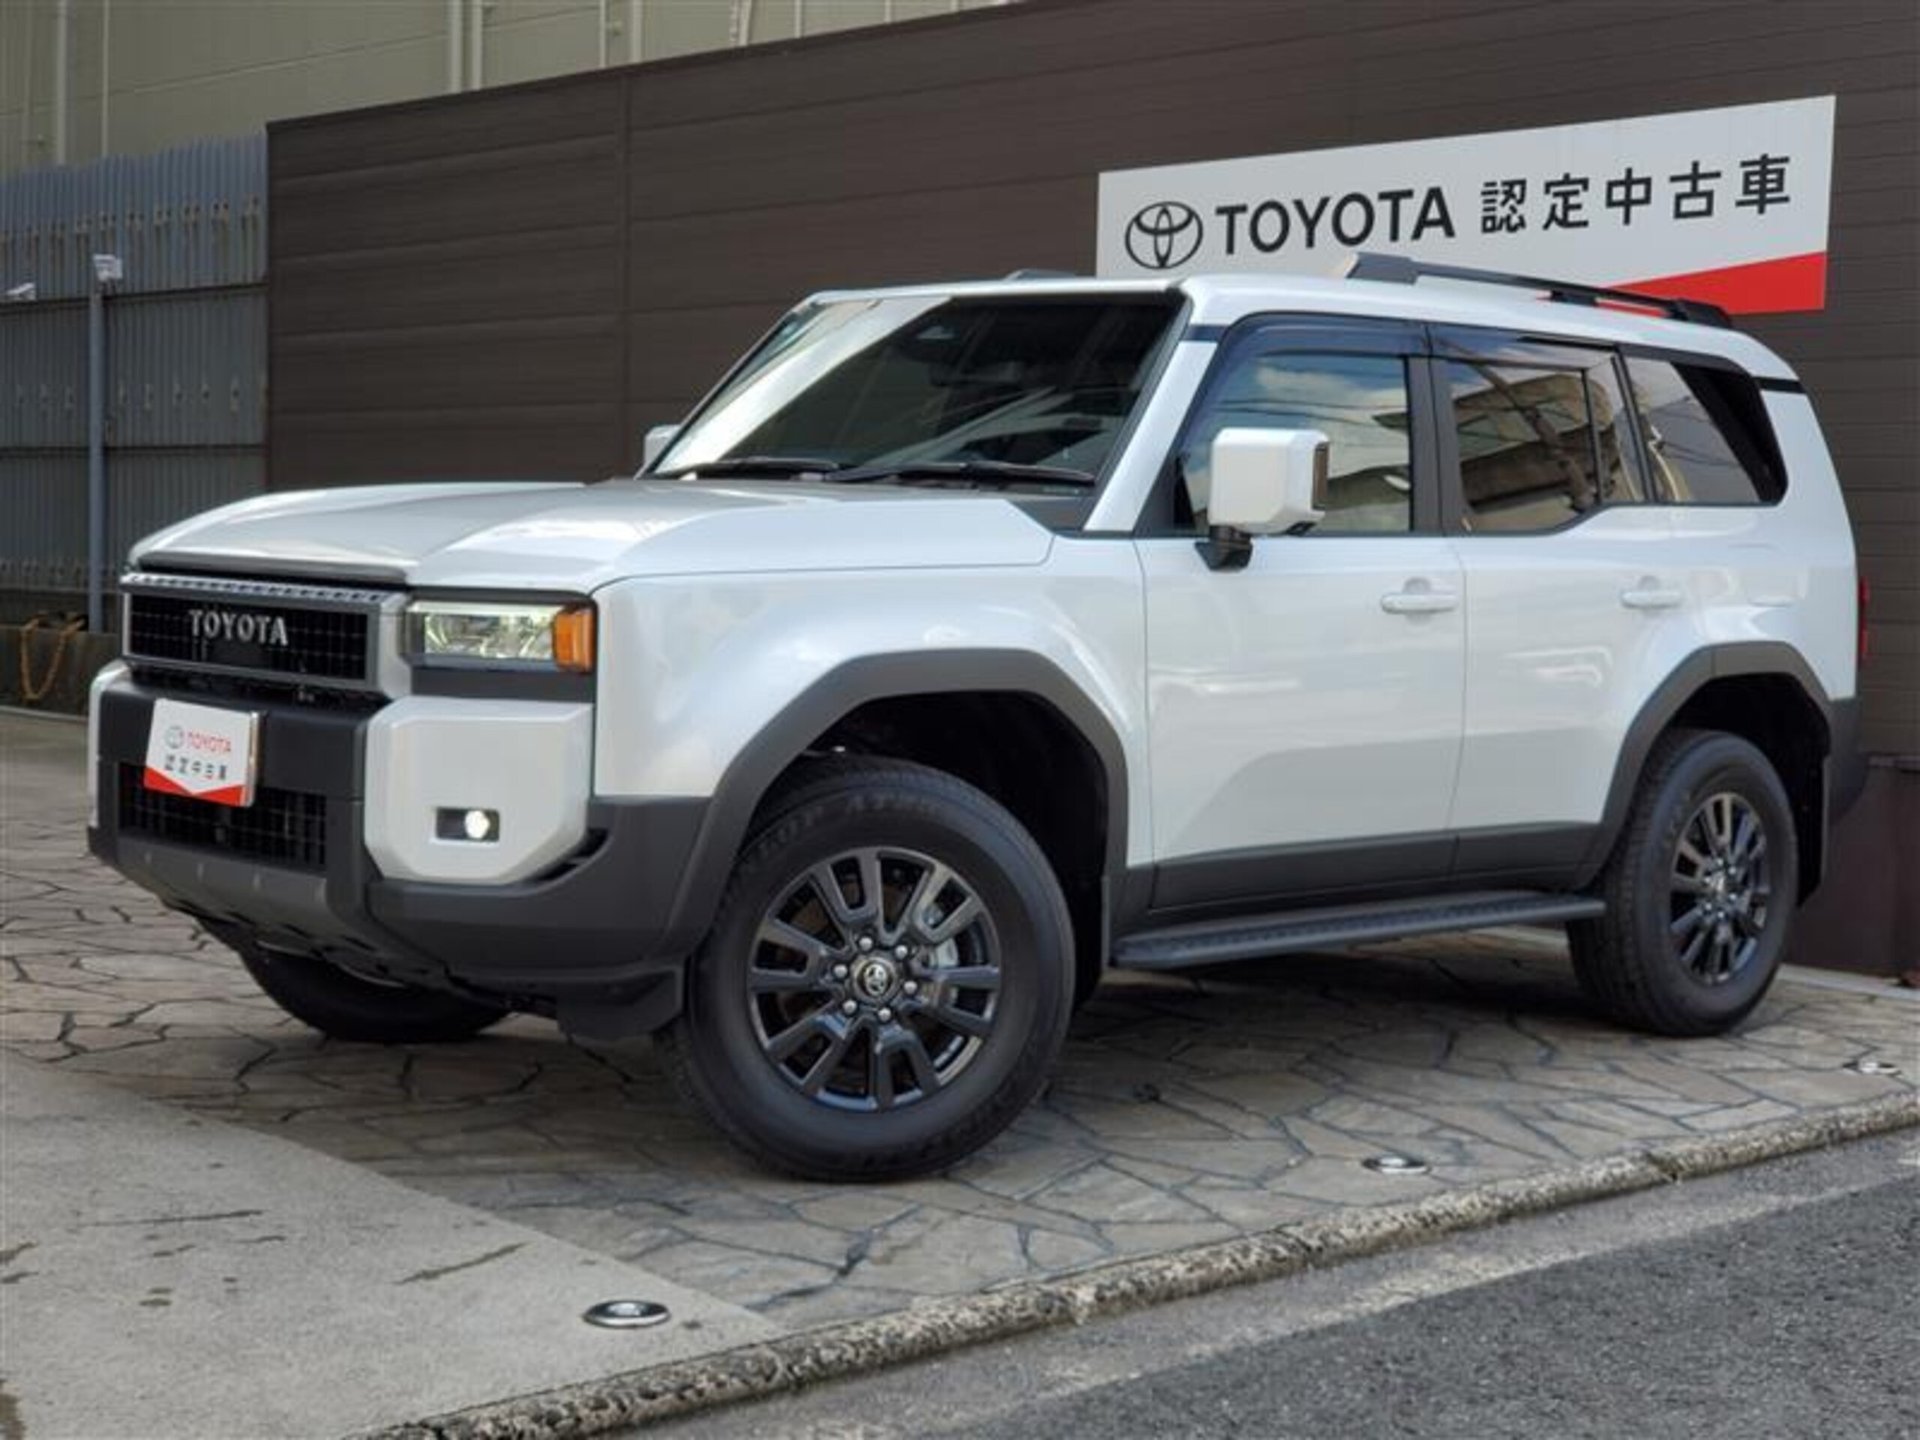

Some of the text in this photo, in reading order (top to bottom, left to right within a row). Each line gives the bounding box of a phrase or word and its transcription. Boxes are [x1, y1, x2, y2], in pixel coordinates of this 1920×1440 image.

[1215, 153, 1791, 255] TOYOTA 認定中古車
[188, 609, 288, 646] TOYOTA
[187, 730, 232, 753] TOYOTA
